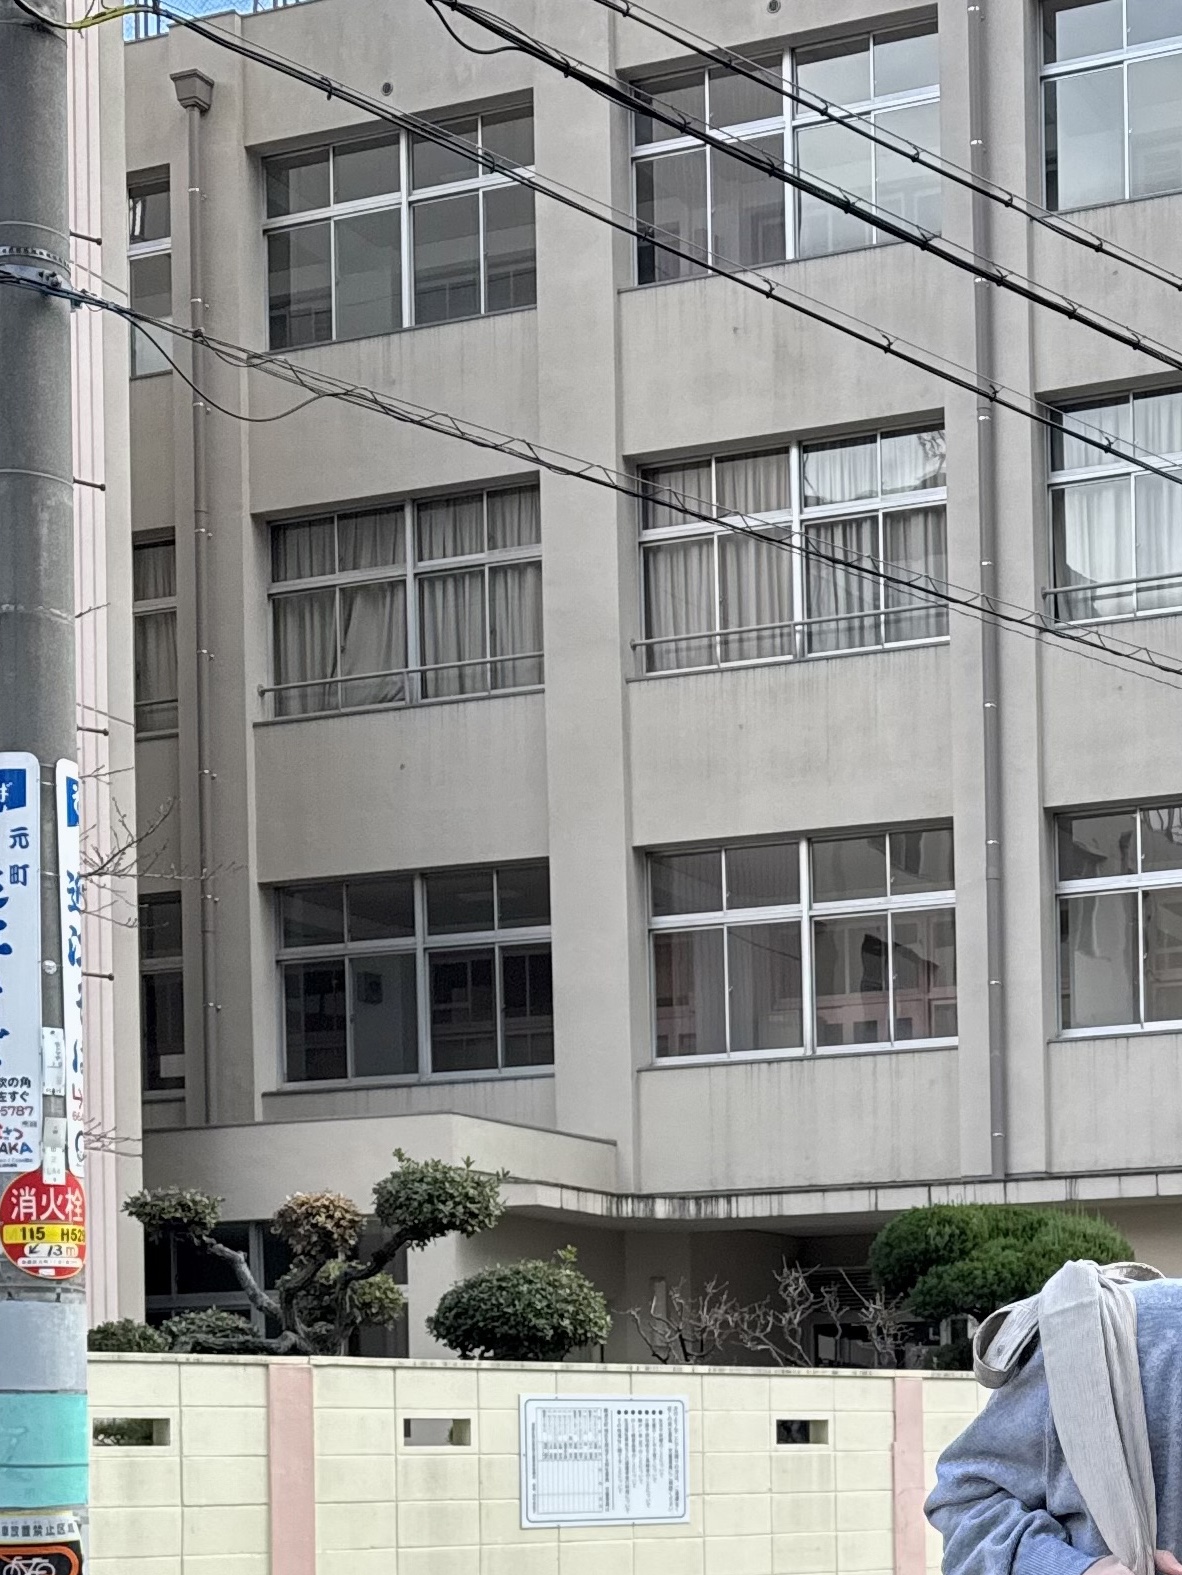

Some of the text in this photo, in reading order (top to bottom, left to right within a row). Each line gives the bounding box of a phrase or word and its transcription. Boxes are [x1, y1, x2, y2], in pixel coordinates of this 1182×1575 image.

[9, 826, 30, 886] 元町
[11, 1186, 84, 1222] 消火栓
